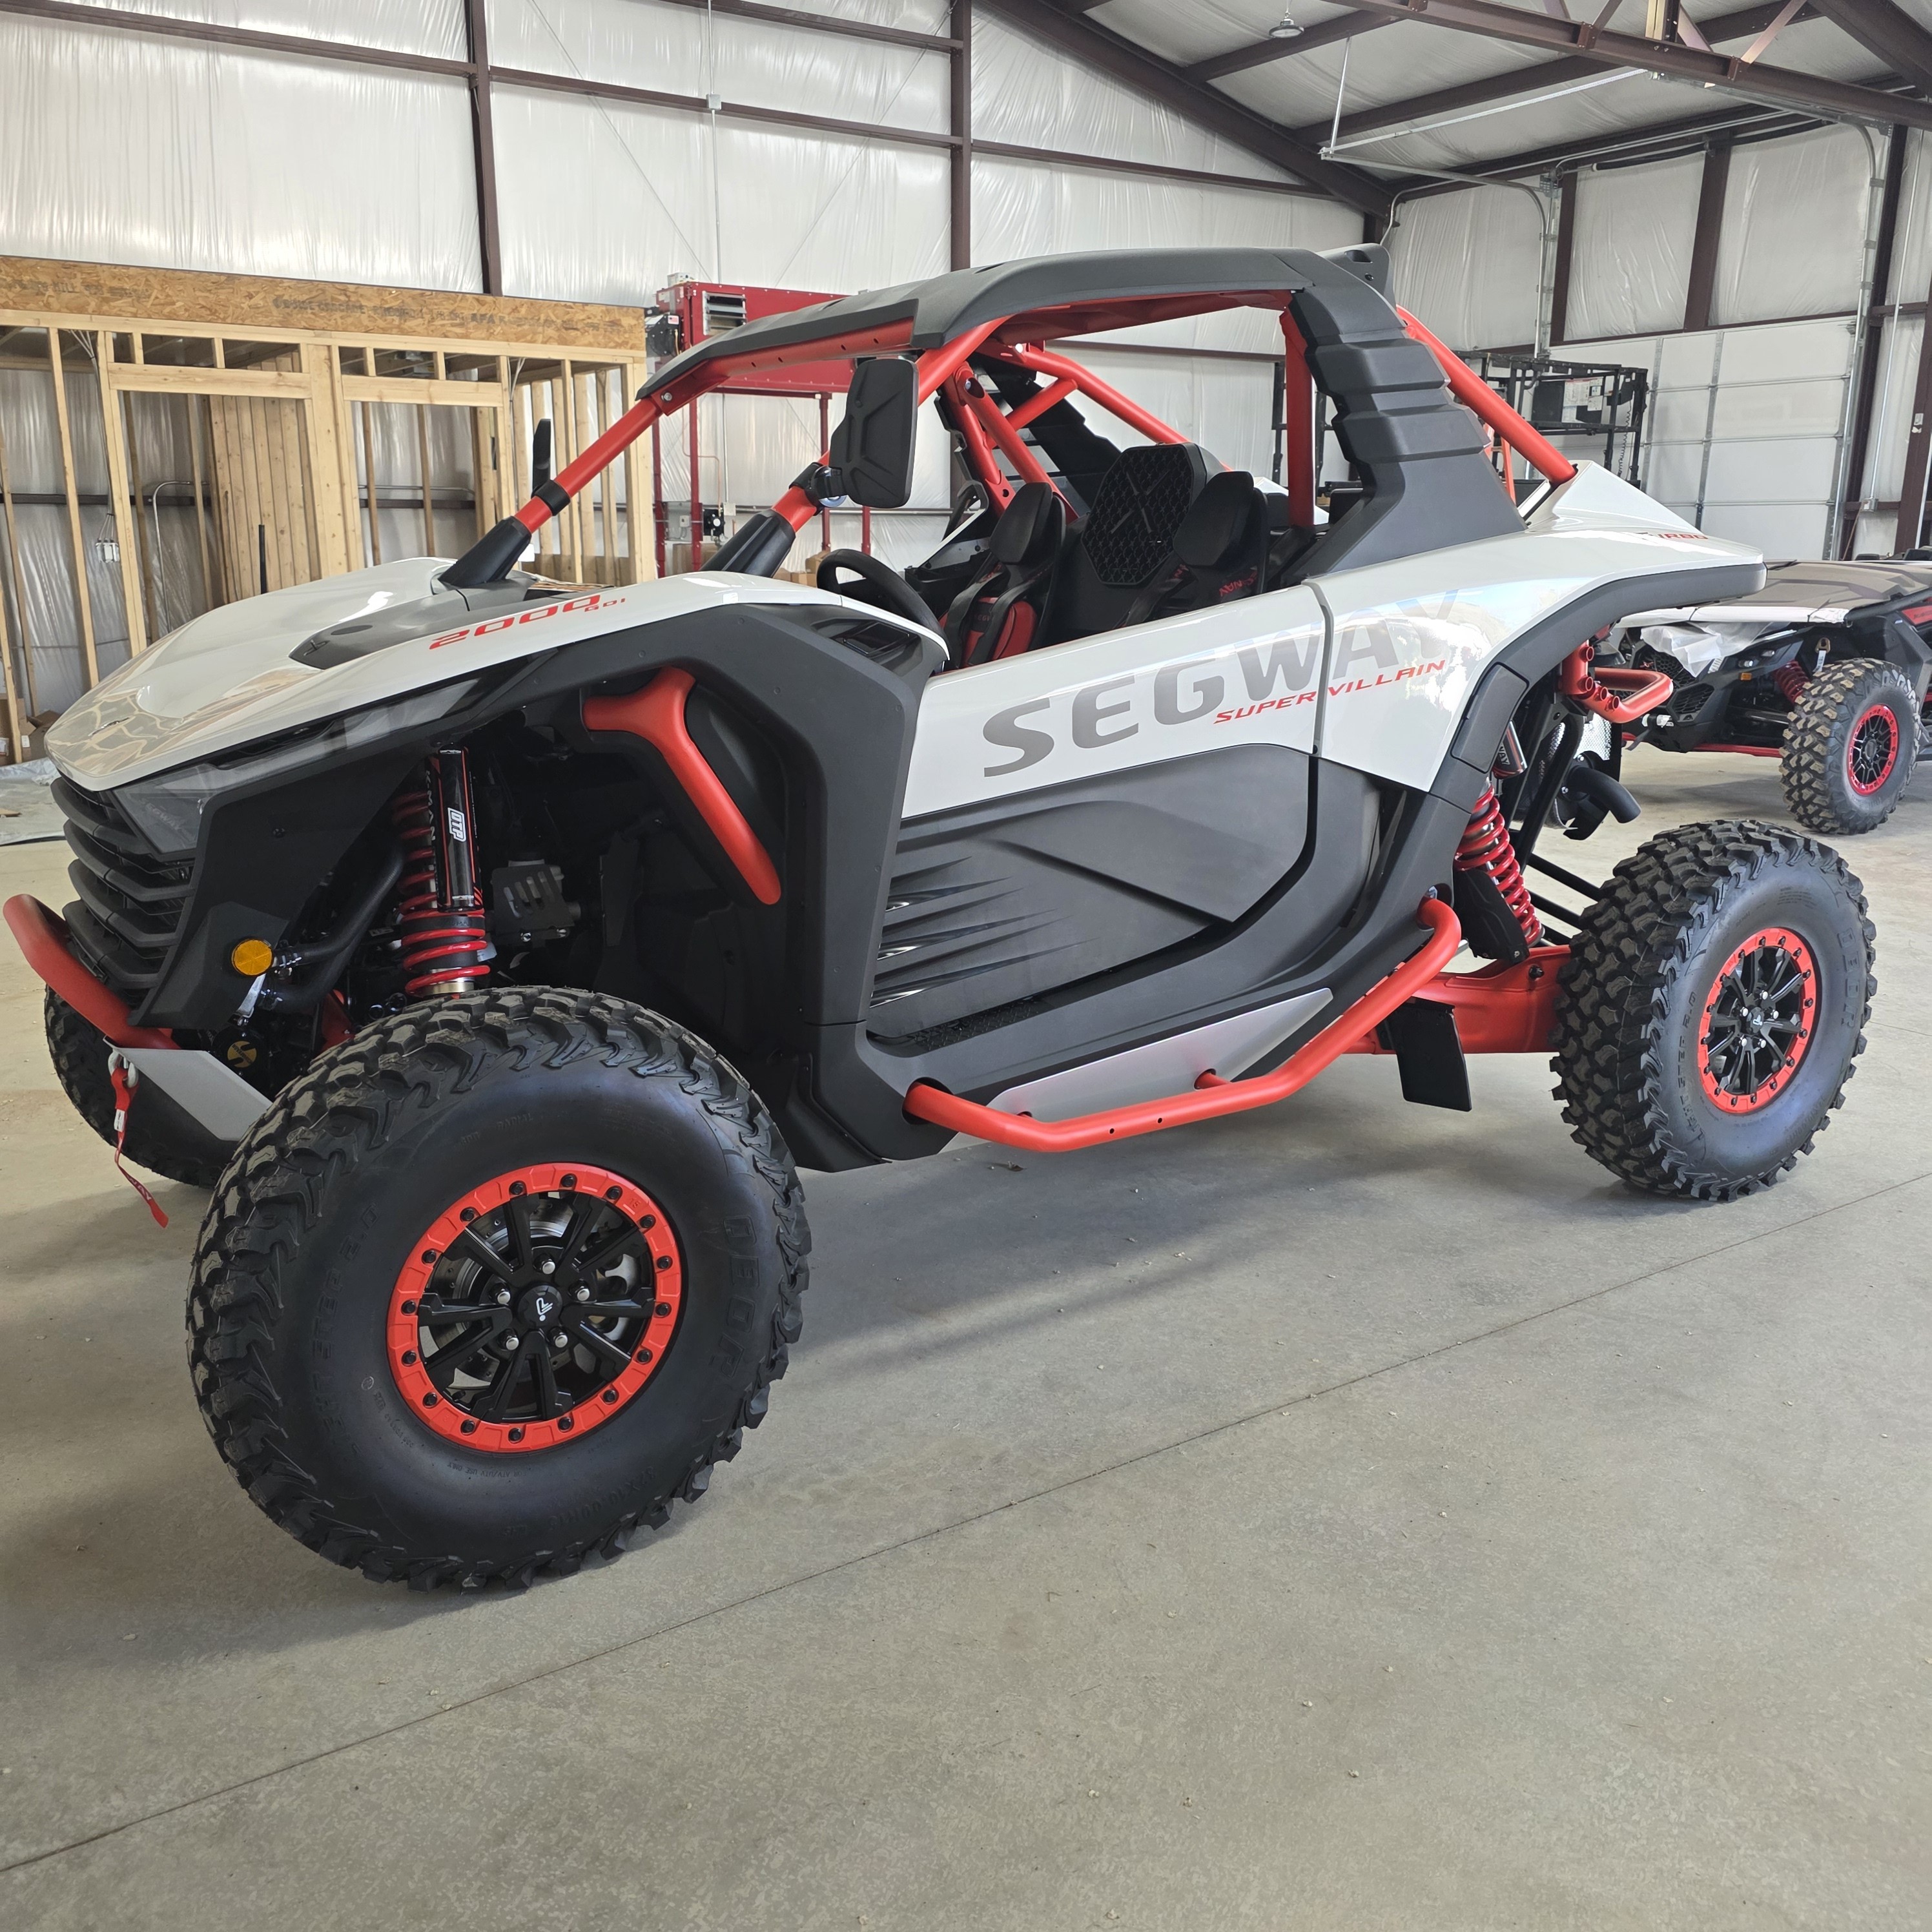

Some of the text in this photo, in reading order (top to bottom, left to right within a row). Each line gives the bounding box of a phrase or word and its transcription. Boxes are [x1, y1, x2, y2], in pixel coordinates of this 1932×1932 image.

[429, 594, 626, 650] 2000 GDI
[983, 589, 1459, 777] SEGWAY
[1213, 659, 1446, 724] SUPER VILLAIN
